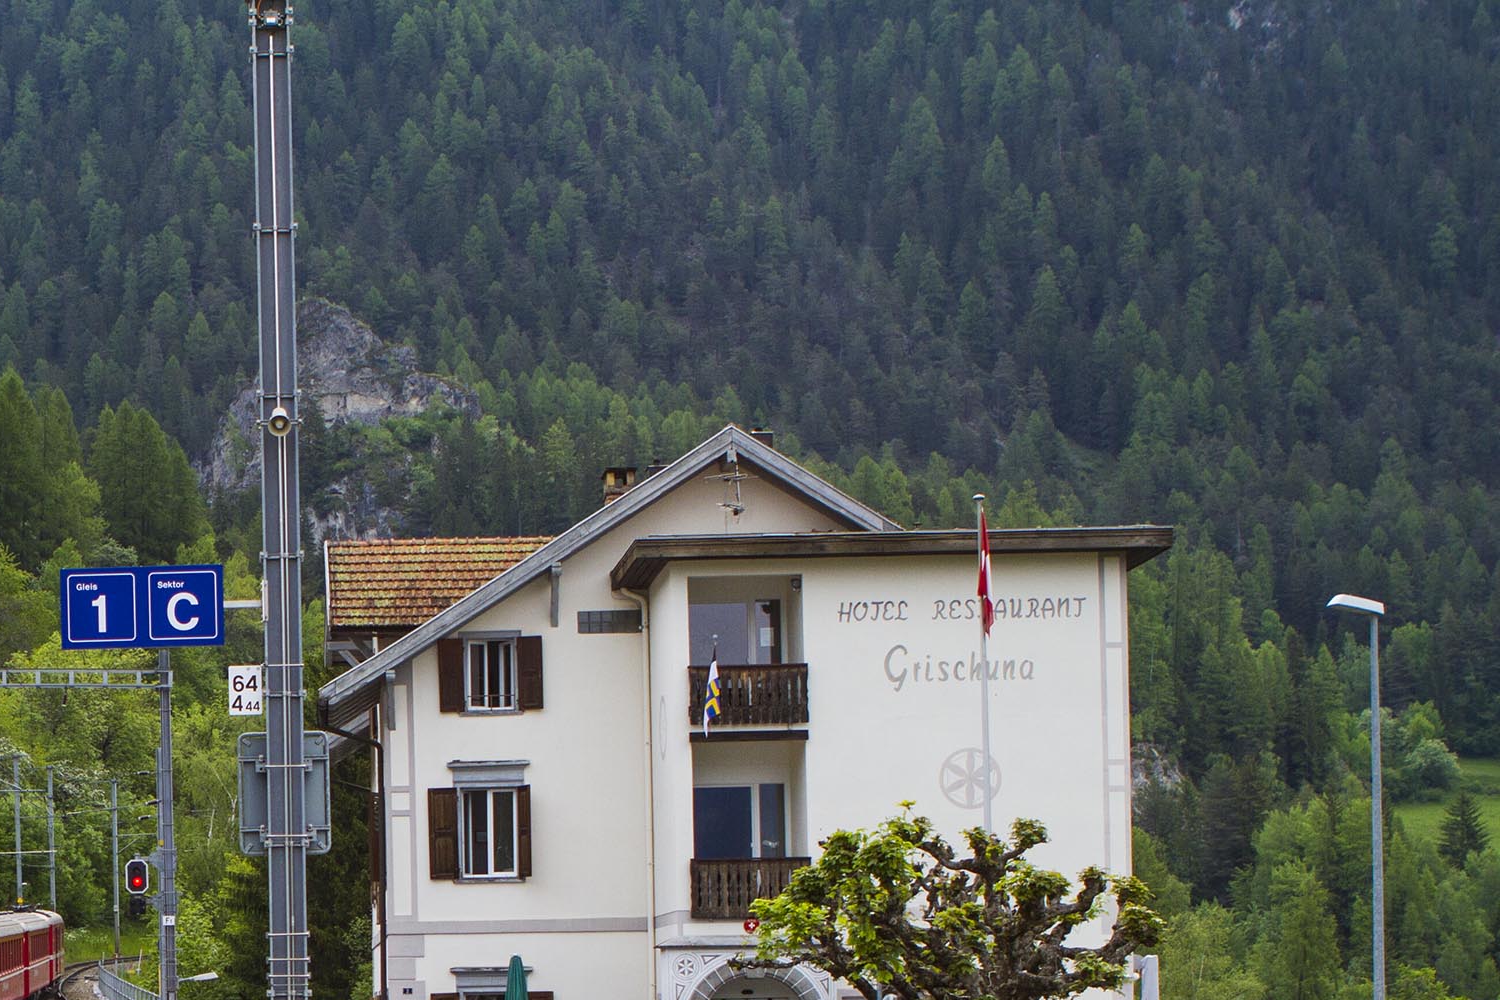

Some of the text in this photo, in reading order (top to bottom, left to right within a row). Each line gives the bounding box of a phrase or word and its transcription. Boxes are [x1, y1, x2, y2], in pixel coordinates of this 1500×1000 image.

[76, 582, 98, 591] Gleis
[157, 580, 185, 589] Sektor
[91, 595, 107, 633] 1
[166, 592, 199, 631] C
[837, 597, 1087, 623] HOTEL RESAURANT
[883, 644, 1035, 692] Grischuna
[232, 674, 258, 692] 64
[231, 695, 260, 711] 4 44
